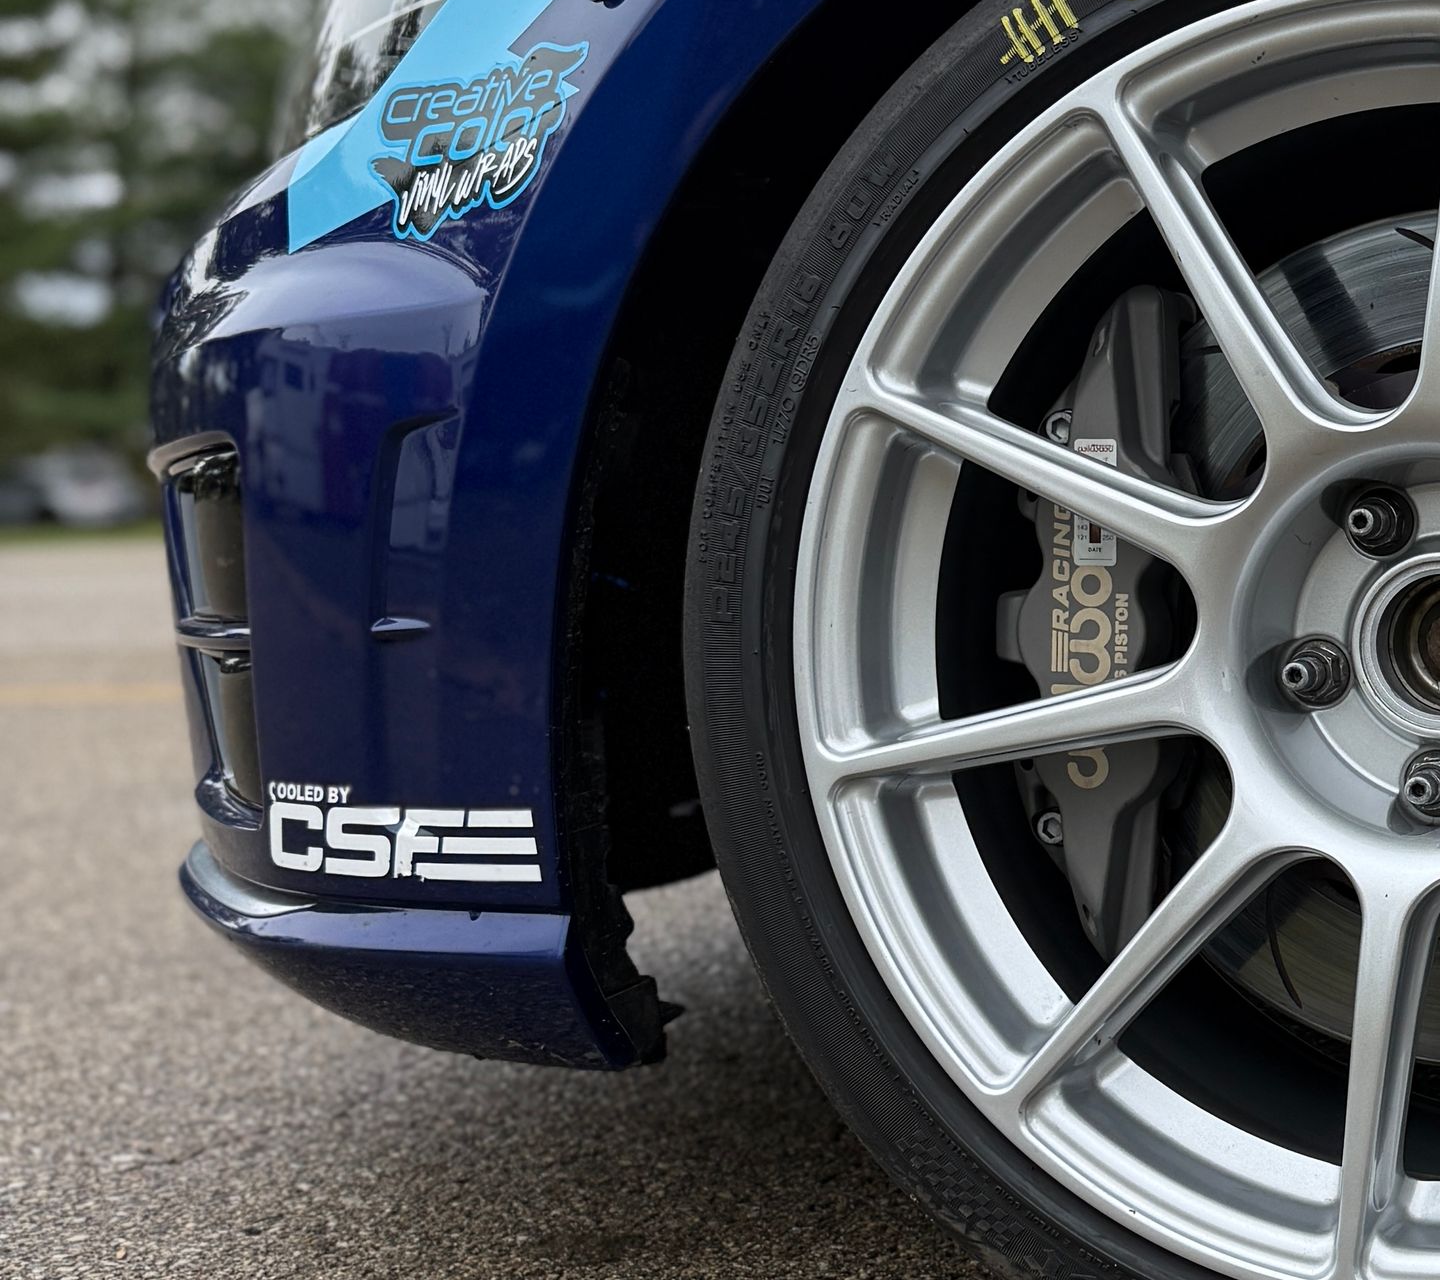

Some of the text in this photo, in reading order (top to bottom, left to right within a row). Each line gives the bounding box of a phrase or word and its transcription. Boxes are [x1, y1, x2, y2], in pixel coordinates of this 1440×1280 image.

[879, 171, 919, 223] RADIAL
[1114, 593, 1129, 664] PISTON
[327, 786, 350, 804] BY
